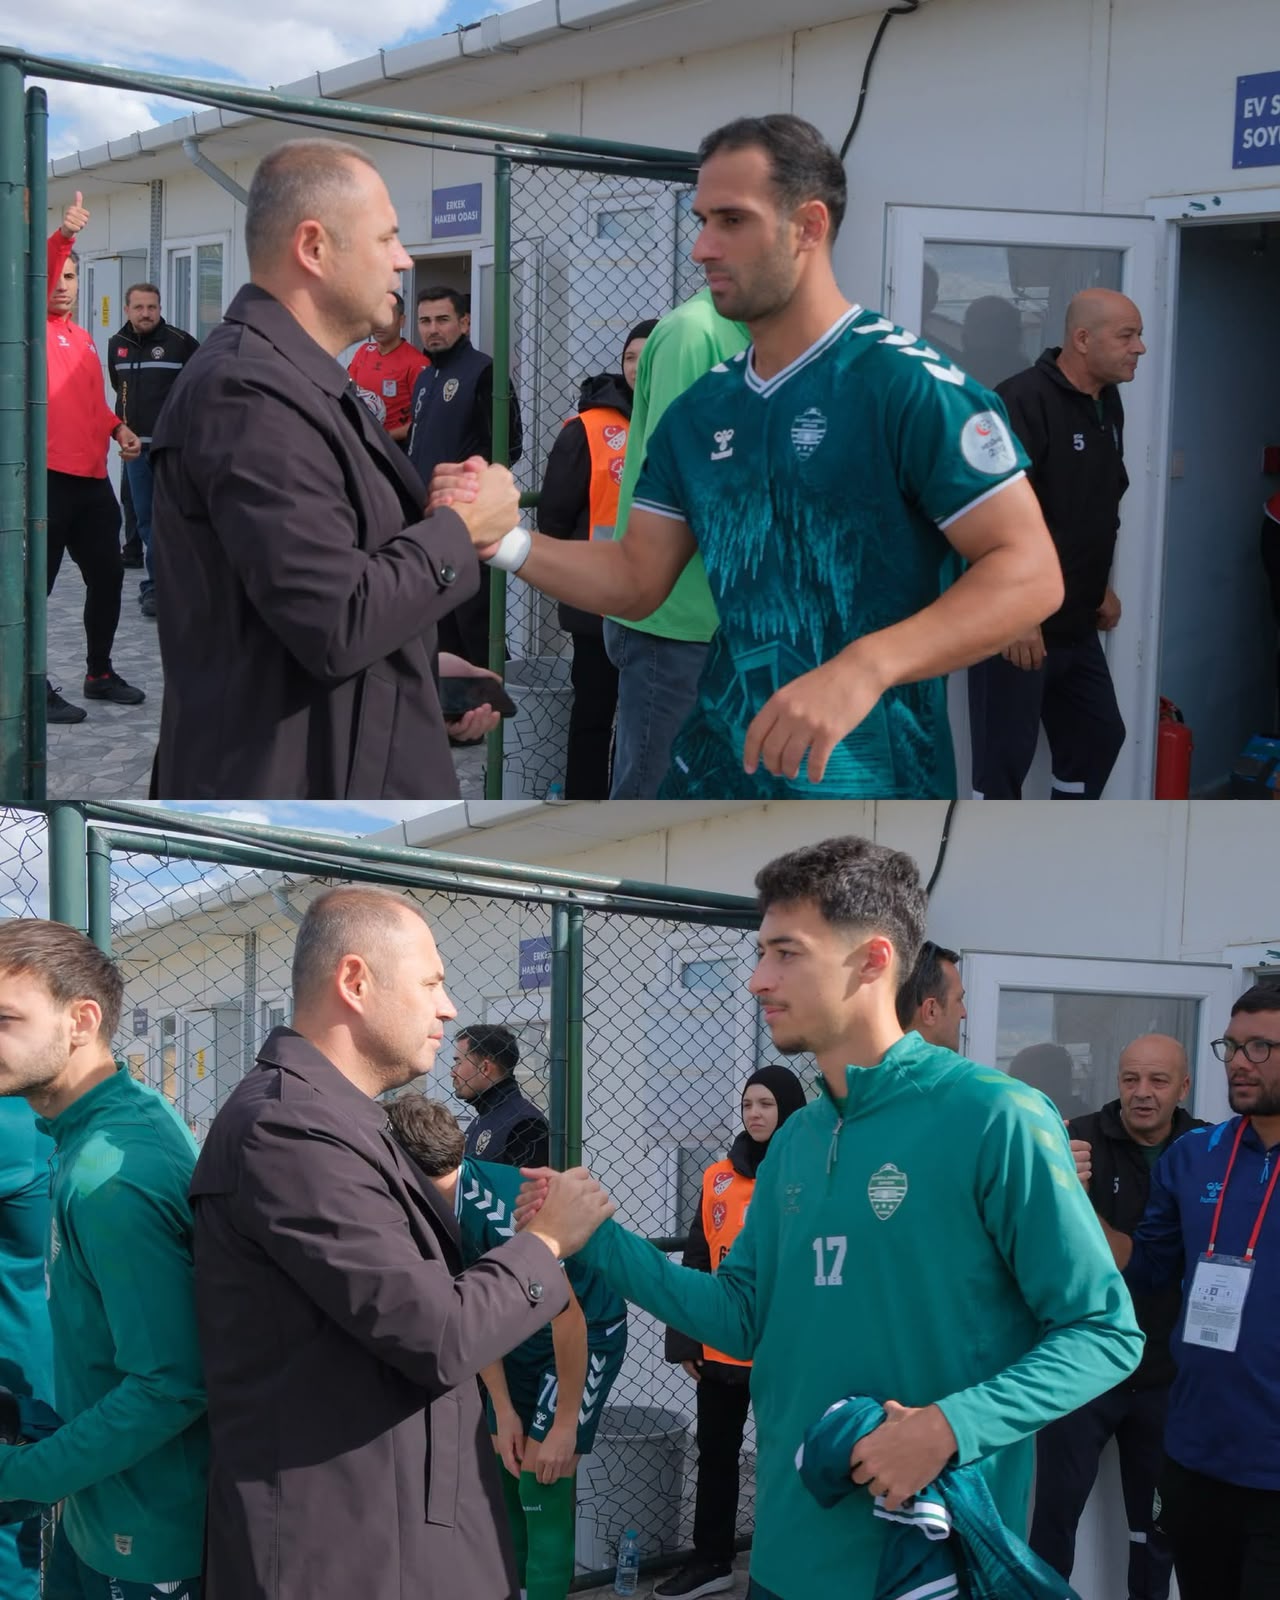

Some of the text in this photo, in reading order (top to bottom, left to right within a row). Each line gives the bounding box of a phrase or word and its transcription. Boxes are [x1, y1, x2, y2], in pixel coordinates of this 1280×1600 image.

[1243, 96, 1267, 118] EV
[1242, 125, 1280, 149] SOY
[446, 200, 466, 210] ERKEK
[434, 211, 478, 225] HAKEM ODASI
[1073, 433, 1085, 451] 5
[812, 1235, 848, 1286] 17
